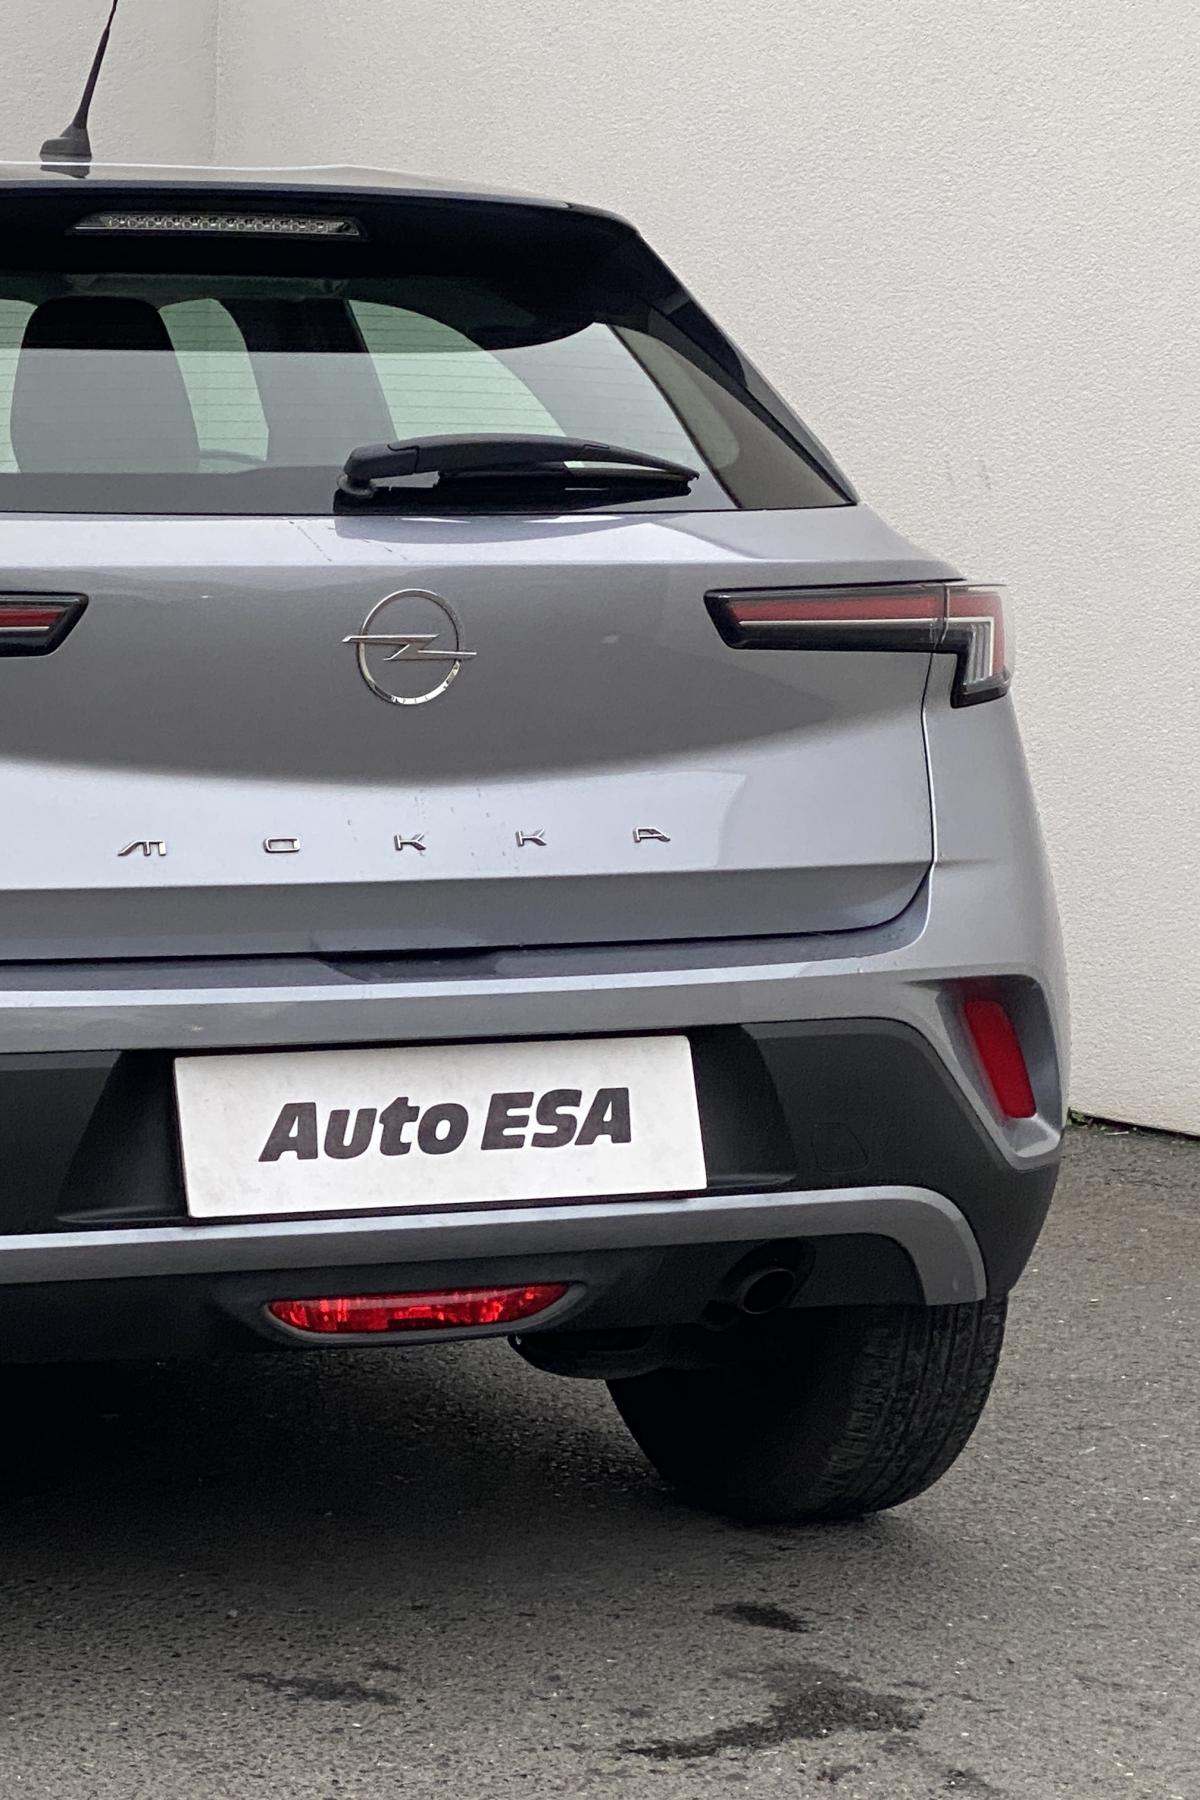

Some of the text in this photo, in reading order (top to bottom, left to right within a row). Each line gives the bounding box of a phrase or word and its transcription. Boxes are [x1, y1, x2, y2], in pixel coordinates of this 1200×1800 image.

[118, 825, 670, 857] MOKKA
[258, 1087, 631, 1163] Auto ESA
